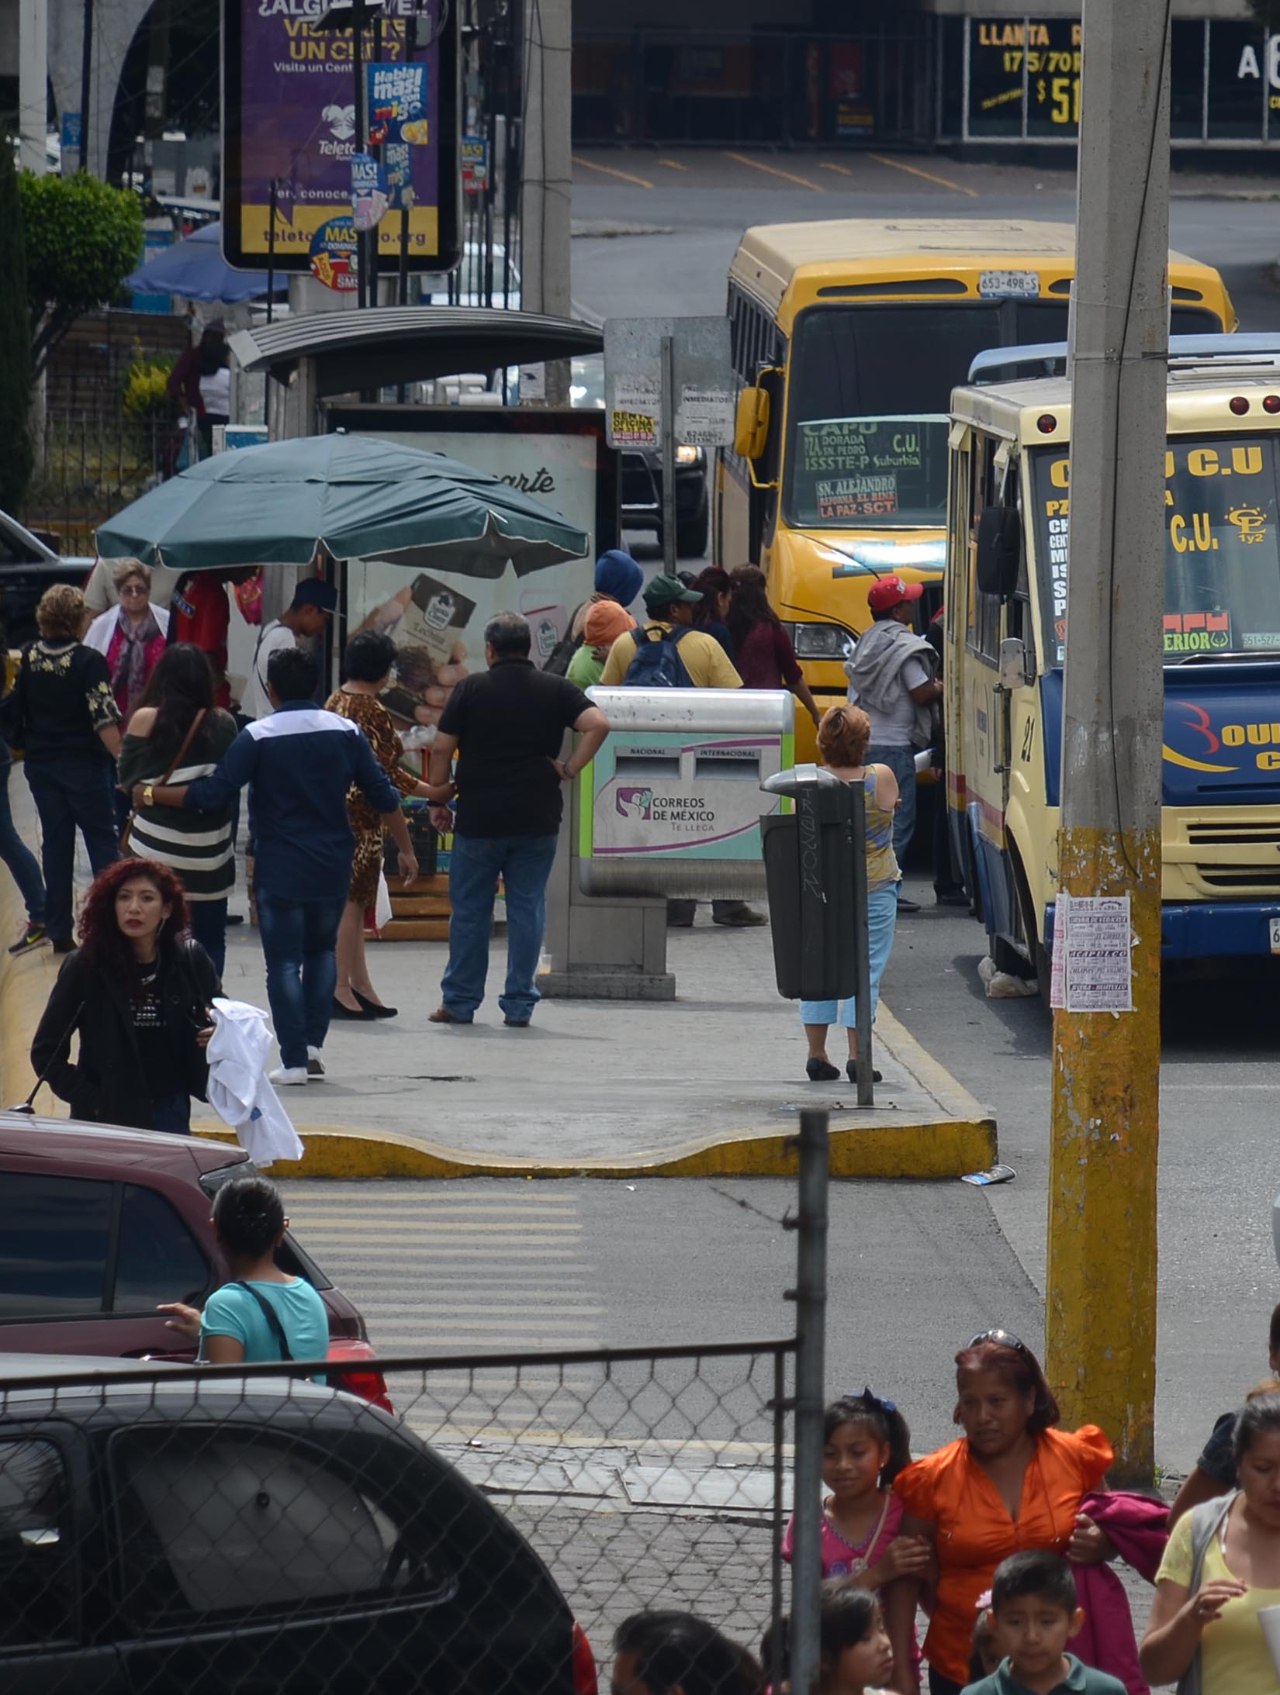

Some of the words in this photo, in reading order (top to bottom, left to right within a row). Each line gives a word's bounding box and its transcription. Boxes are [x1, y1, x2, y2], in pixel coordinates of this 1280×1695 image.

[979, 24, 1050, 46] LLANTA
[289, 41, 326, 61] UN
[274, 62, 306, 73] Visita
[308, 64, 323, 73] un
[1237, 45, 1261, 78] A
[822, 434, 865, 446] DORADA
[893, 433, 919, 453] C.U.
[805, 455, 869, 471] ISSSTE-P
[873, 454, 921, 468] Suburbia
[1187, 446, 1263, 477] C.U
[836, 476, 896, 495] ALEJANDRO
[1170, 512, 1219, 553] C.U.
[630, 748, 667, 756] NACIONAL
[700, 749, 756, 758] INTERNACIONAL
[652, 797, 705, 809] CORREOS
[652, 811, 668, 822] DE
[670, 808, 715, 823] MÉXICO
